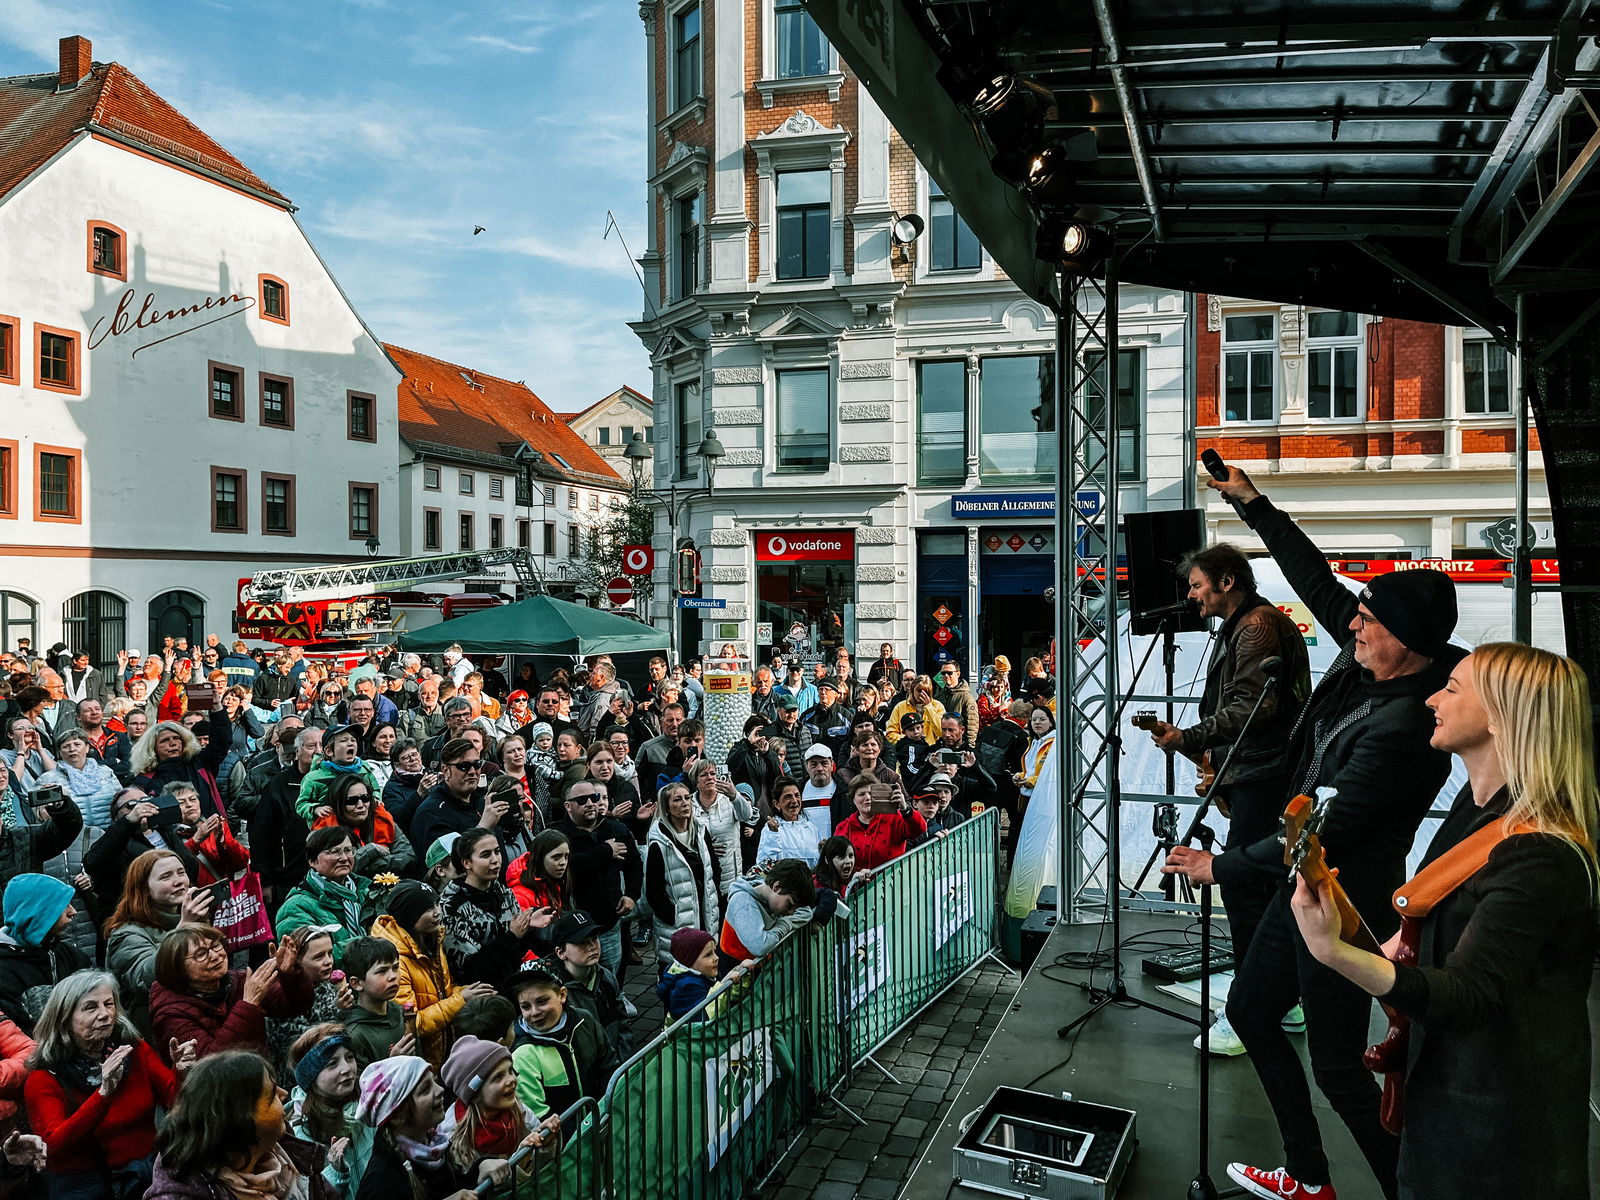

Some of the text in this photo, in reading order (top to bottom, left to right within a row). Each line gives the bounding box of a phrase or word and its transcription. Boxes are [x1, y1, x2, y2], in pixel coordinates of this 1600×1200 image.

[955, 499, 999, 512] DÖBELNER
[1001, 499, 1056, 511] ALLGEMEINE
[789, 539, 842, 552] vodafone
[1394, 561, 1475, 572] MOCKRITZ
[683, 598, 721, 609] Obermarkt
[214, 895, 257, 919] GARTEN
[213, 902, 261, 928] FREIZEIT
